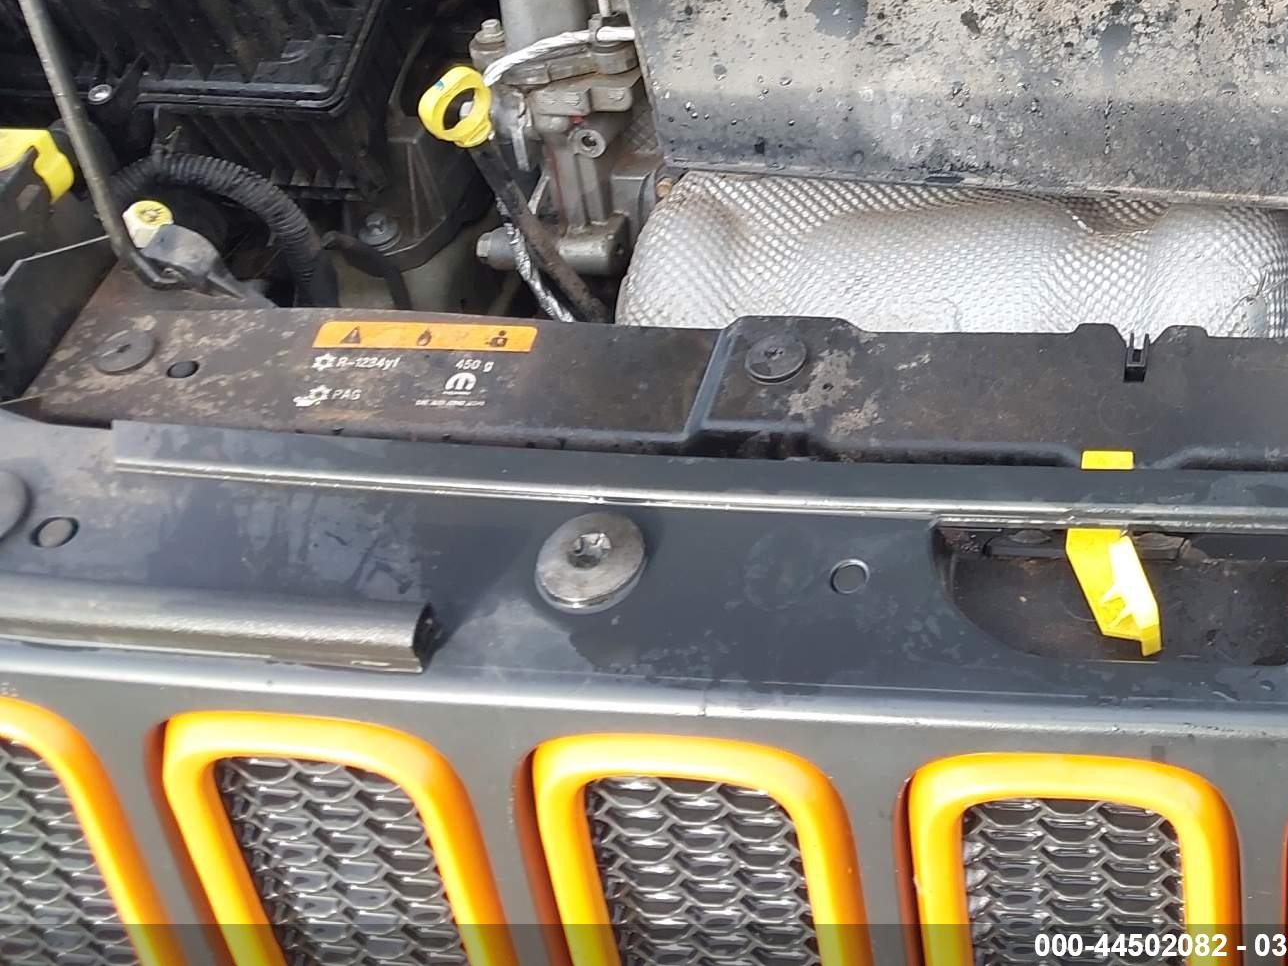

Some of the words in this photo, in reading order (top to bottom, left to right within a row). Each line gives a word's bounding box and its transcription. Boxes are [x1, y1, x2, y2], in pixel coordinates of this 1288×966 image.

[455, 359, 482, 370] 450
[483, 361, 495, 372] g
[331, 389, 361, 400] PAG
